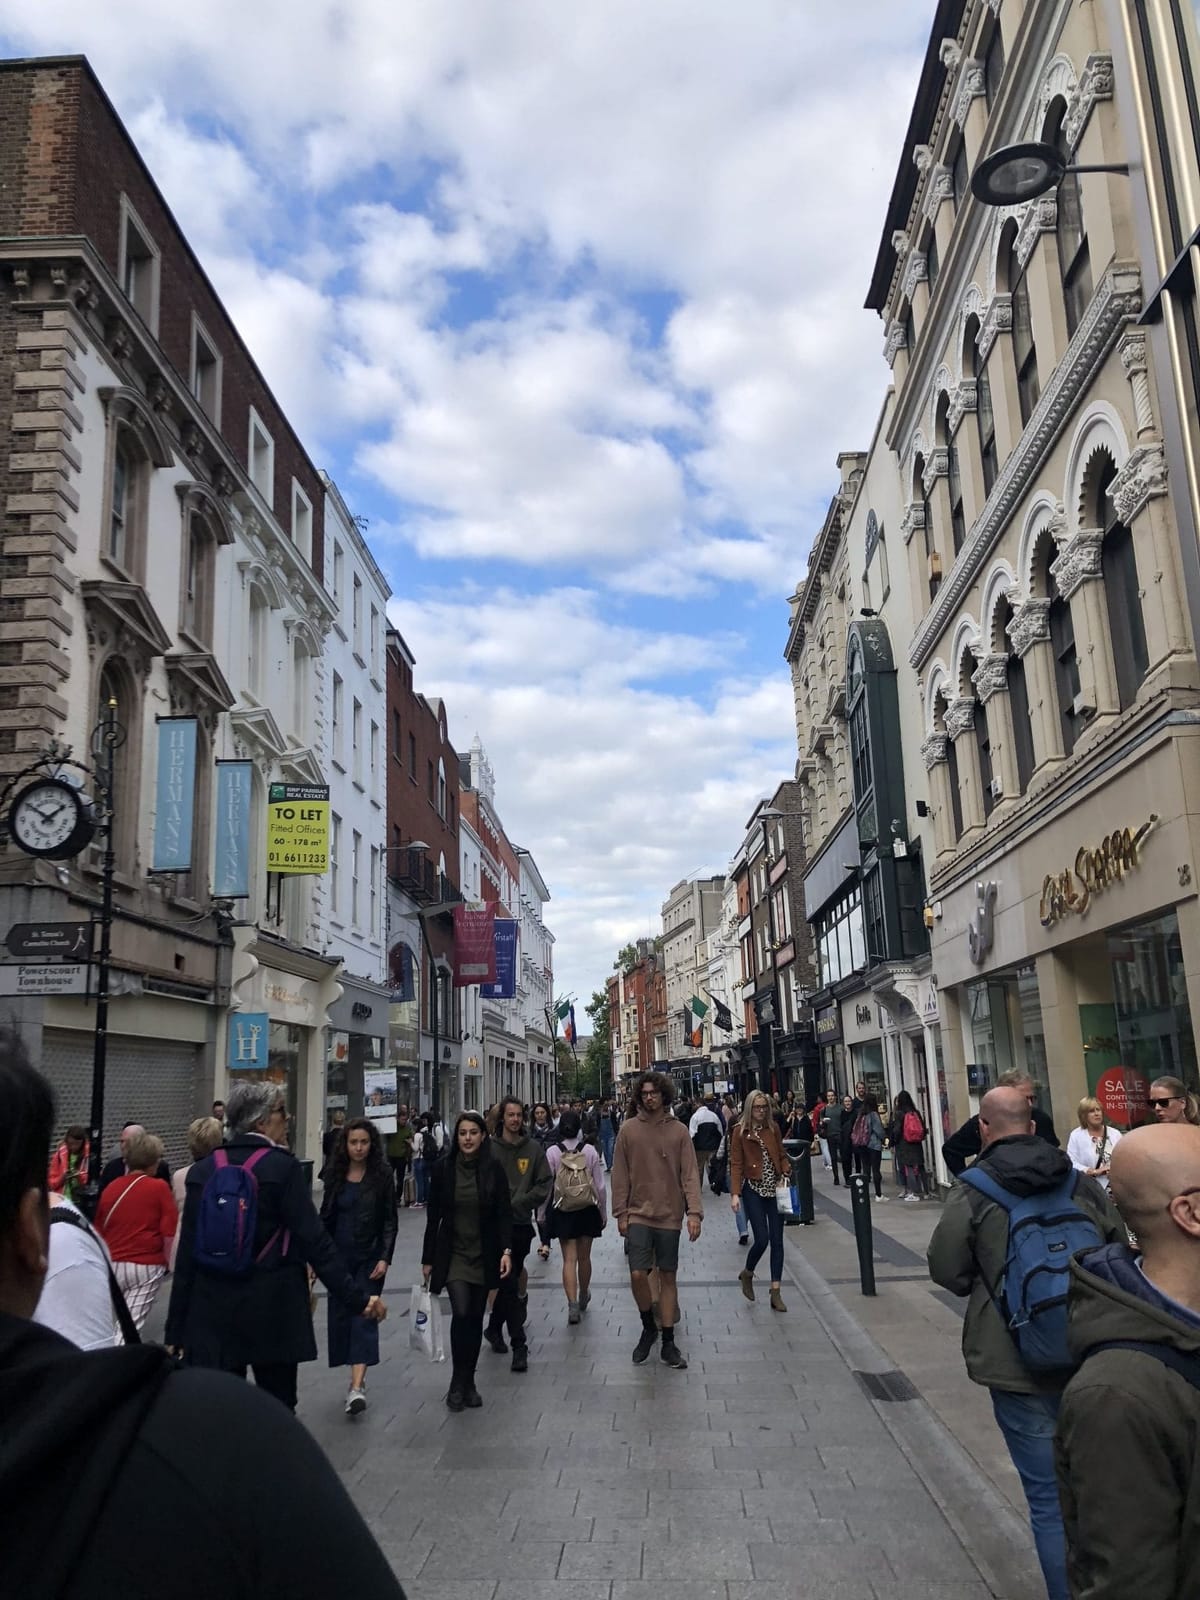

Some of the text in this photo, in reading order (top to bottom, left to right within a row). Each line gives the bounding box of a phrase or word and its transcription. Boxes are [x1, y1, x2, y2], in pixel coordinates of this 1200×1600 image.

[275, 808, 323, 821] TO LET
[270, 824, 326, 834] Fitted Offices
[269, 852, 326, 863] 01 6611233
[17, 965, 80, 975] Powerscourt
[17, 975, 73, 986] Townhouse
[1105, 1080, 1144, 1092] SALE
[1106, 1102, 1145, 1110] IN-STORE
